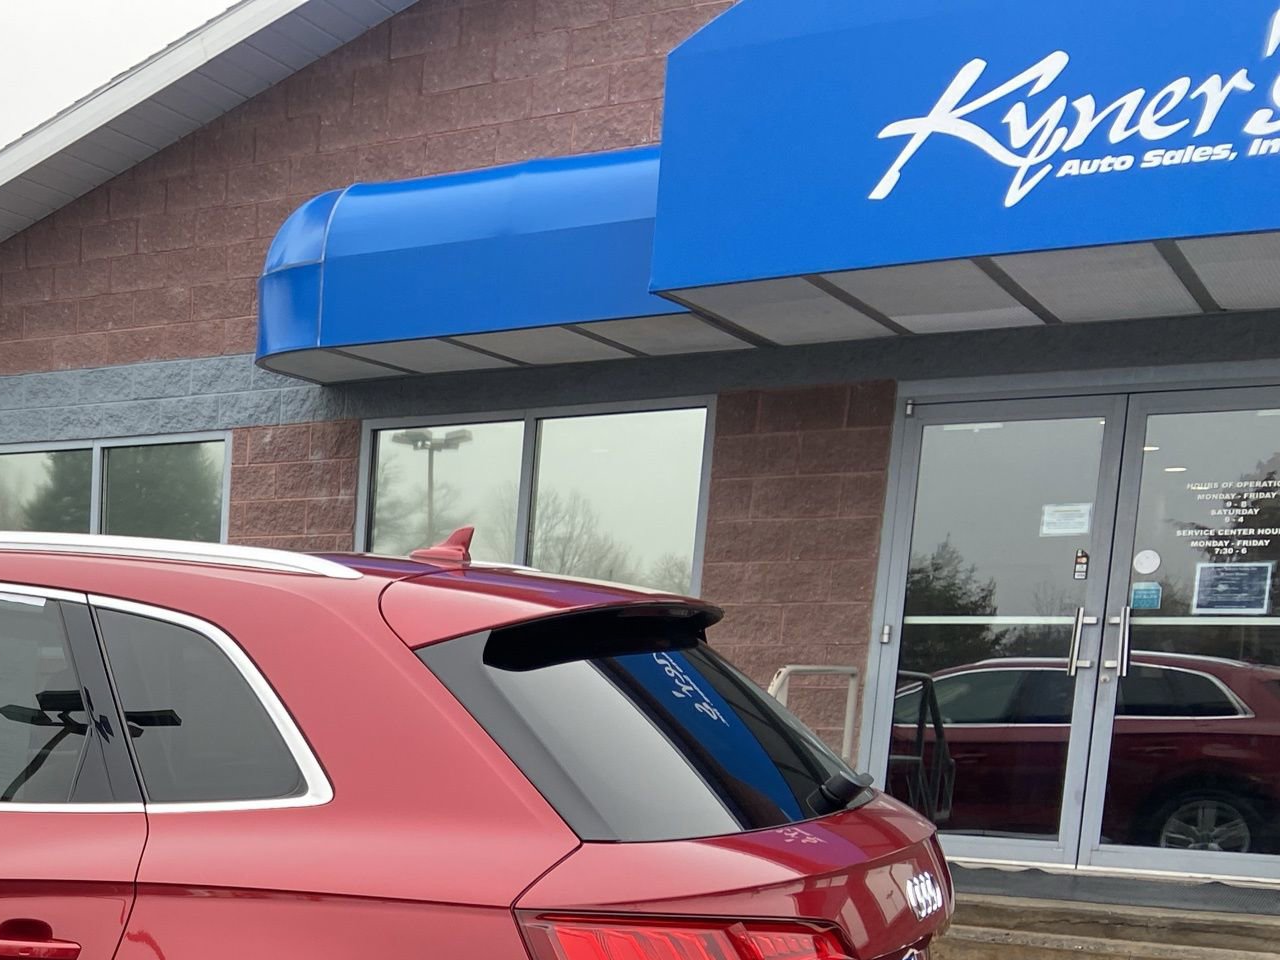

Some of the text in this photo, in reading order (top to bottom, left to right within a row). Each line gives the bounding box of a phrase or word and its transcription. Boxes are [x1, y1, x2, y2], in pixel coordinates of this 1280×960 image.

[1056, 154, 1135, 178] Auto
[1140, 144, 1238, 169] Sales,
[1221, 481, 1234, 489] OF
[1210, 508, 1260, 516] SATURDAY
[1176, 529, 1216, 537] SERVICE
[1218, 528, 1255, 536] CENTER
